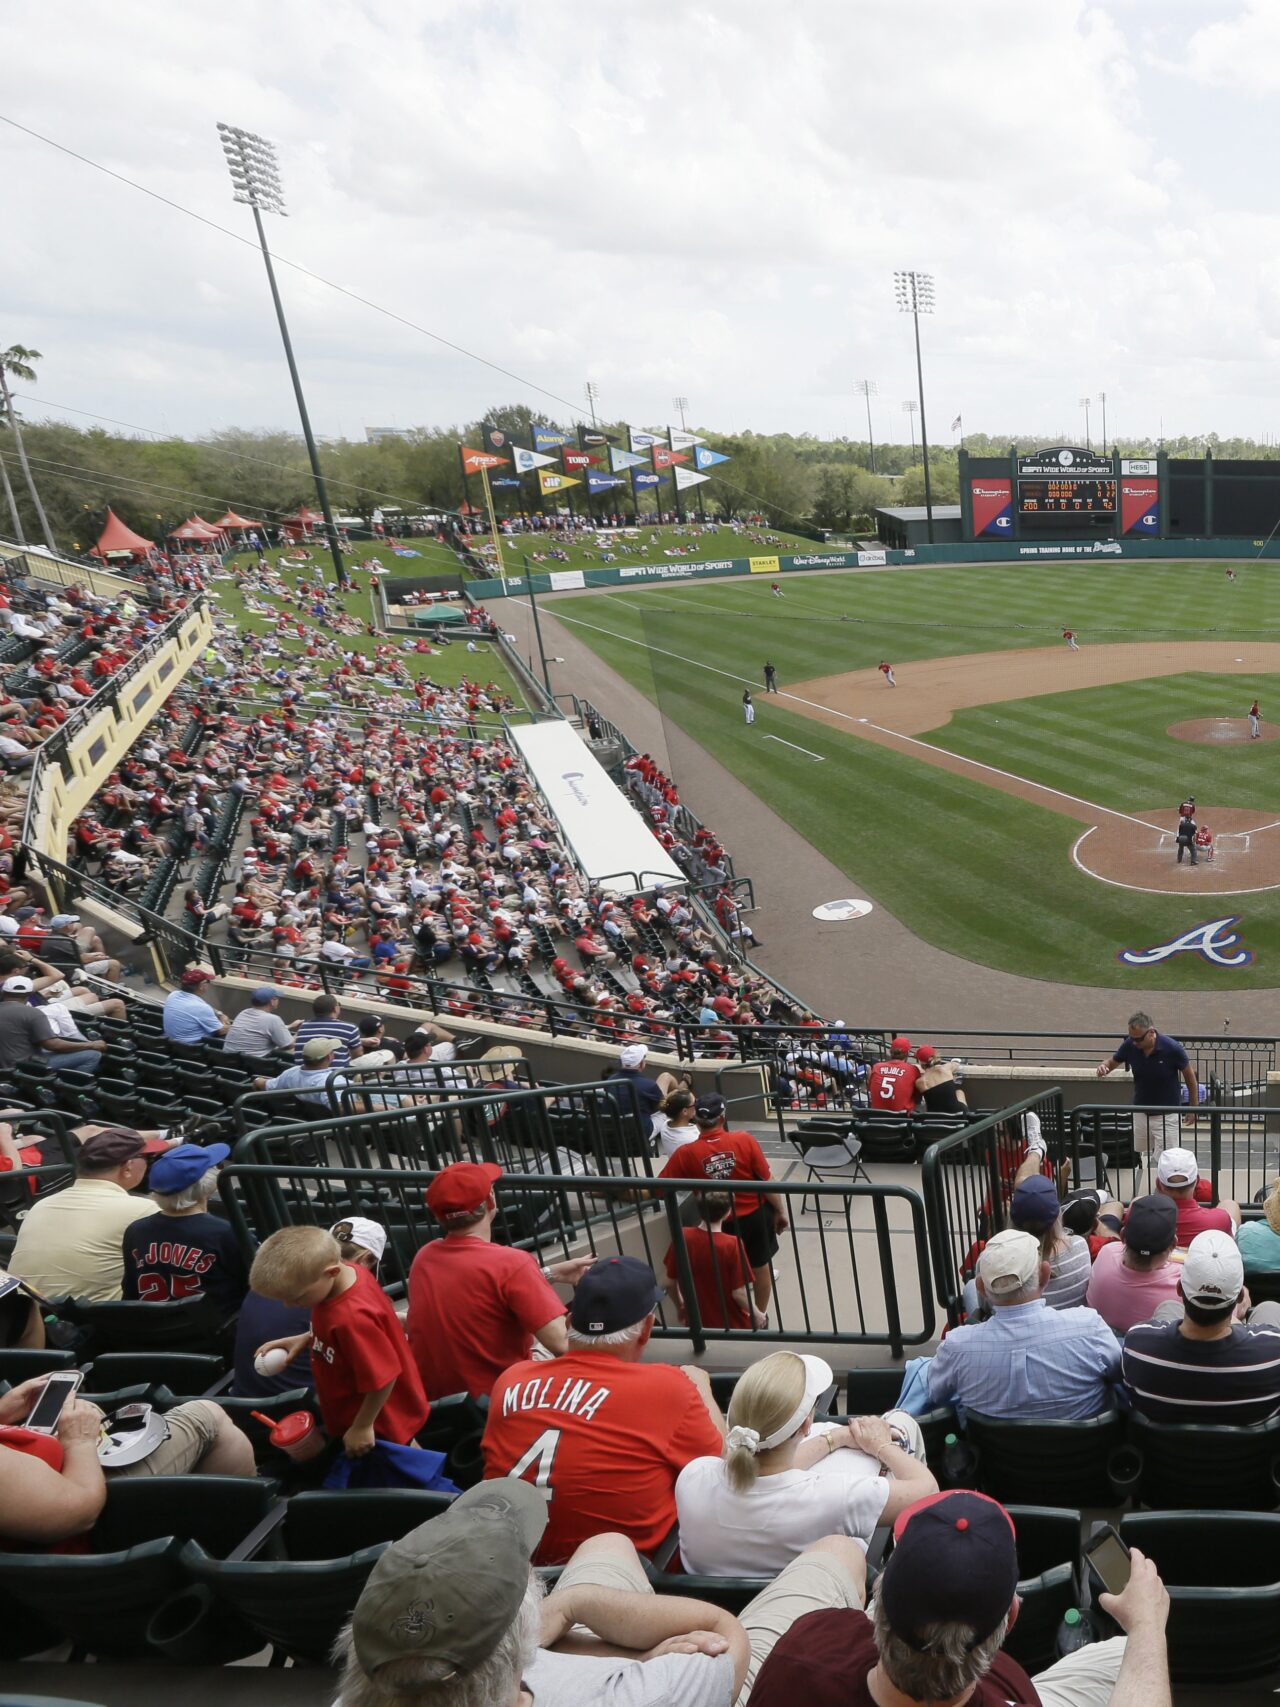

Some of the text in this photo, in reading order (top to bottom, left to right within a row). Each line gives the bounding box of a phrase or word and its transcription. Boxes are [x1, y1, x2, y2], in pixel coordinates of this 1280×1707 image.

[620, 568, 646, 576] ESPN
[647, 566, 668, 574] WIDE
[669, 564, 696, 572] WORLD
[705, 561, 732, 570] SPORTS
[880, 1066, 905, 1076] PUJOLS
[880, 1076, 896, 1098] 5
[502, 1376, 610, 1420] MOLINA
[507, 1428, 562, 1502] 4
